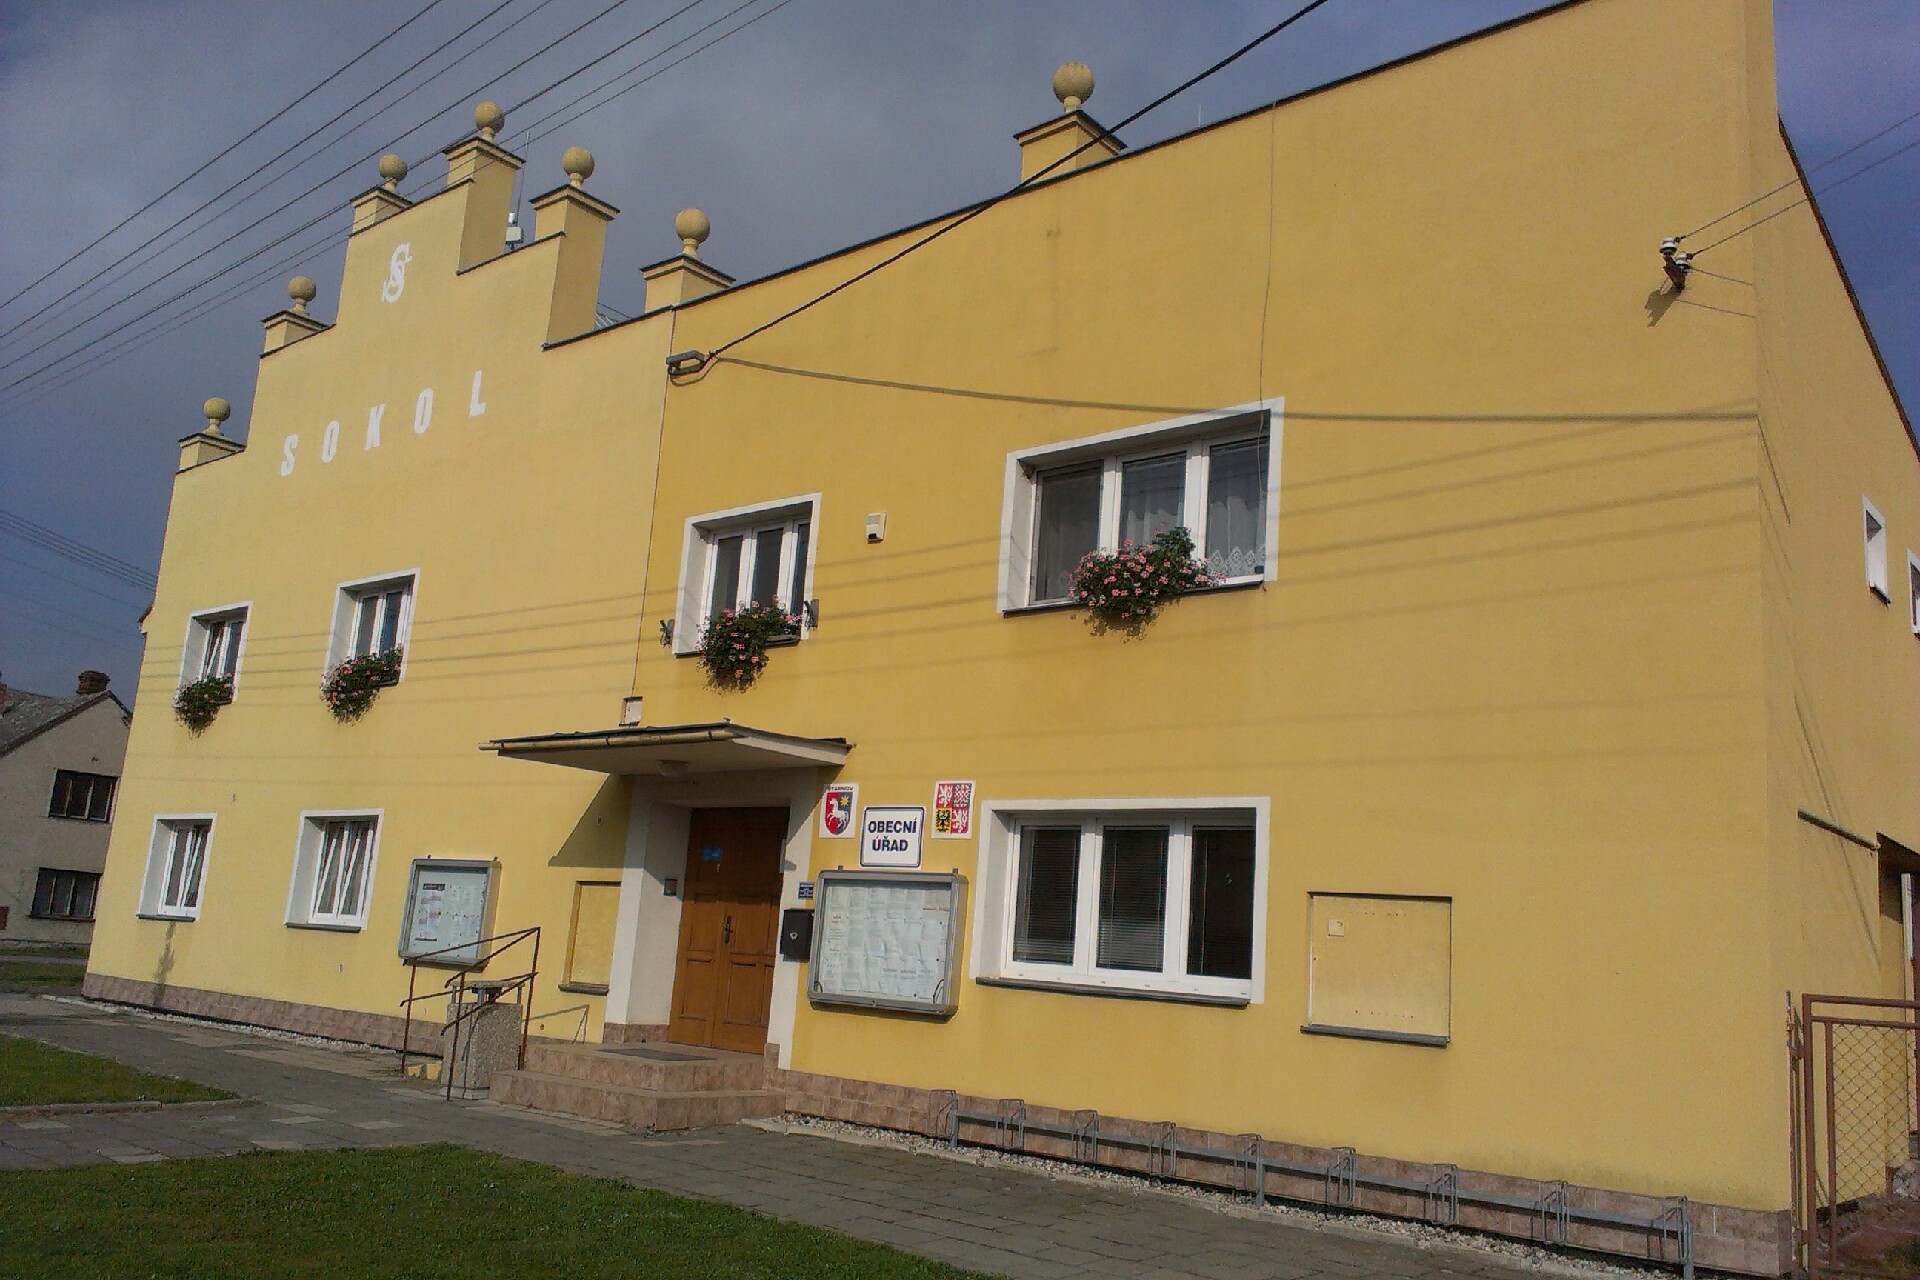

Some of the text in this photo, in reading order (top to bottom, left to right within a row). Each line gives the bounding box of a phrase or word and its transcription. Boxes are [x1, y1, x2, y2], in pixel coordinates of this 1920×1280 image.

[380, 242, 413, 304] S
[280, 369, 486, 476] SOKOL
[868, 817, 917, 833] OBECNÍ
[872, 835, 908, 852] ÚŘAD
